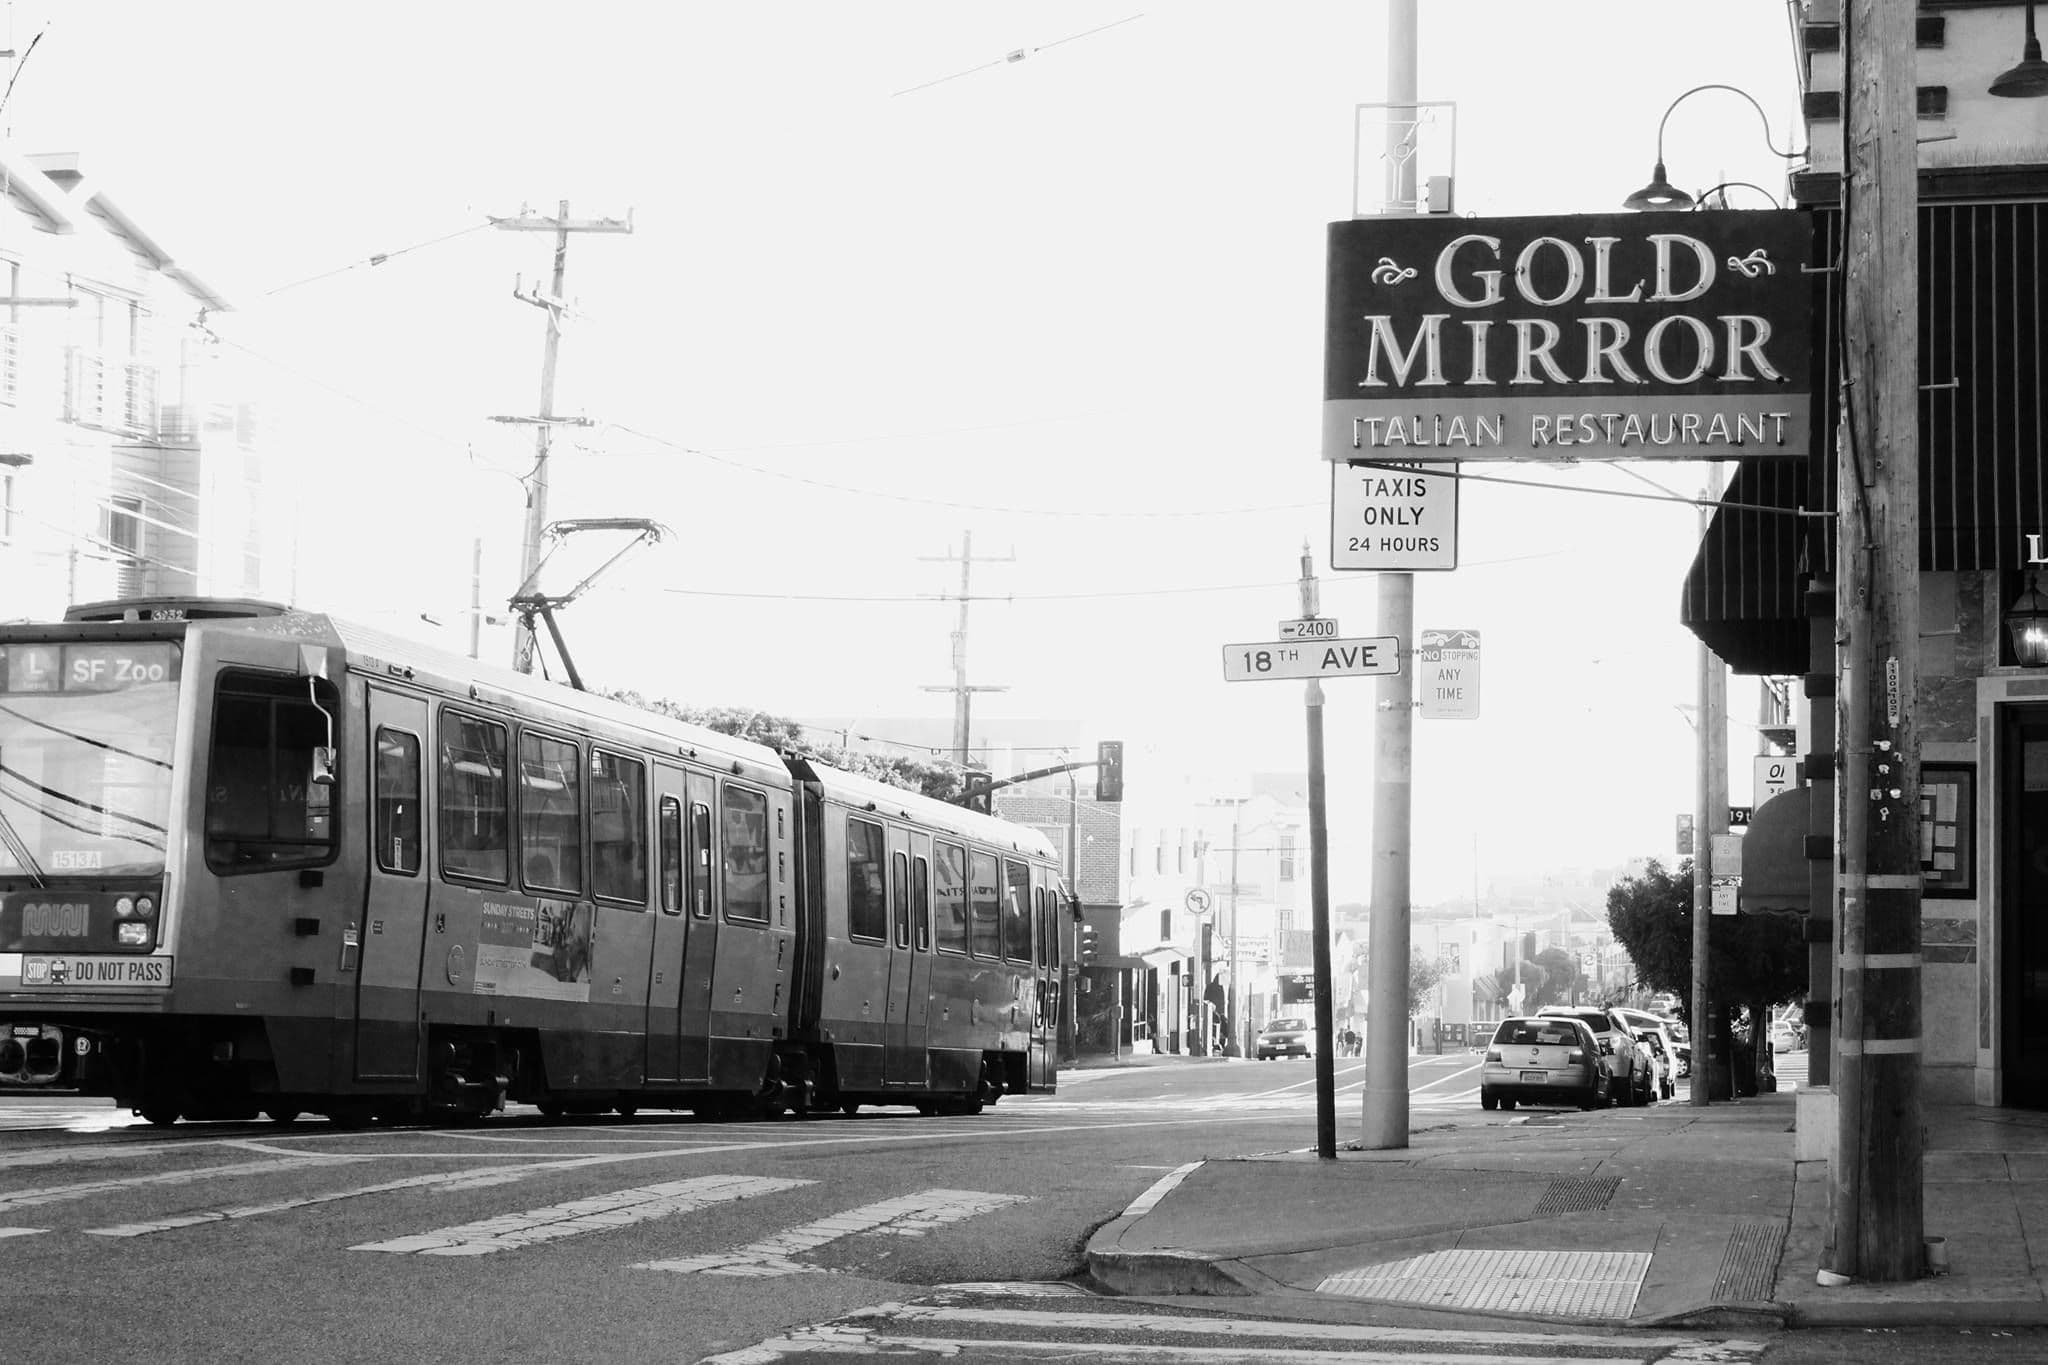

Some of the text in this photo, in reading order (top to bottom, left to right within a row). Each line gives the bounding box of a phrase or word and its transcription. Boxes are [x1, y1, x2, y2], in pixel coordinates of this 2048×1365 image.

[1435, 234, 1716, 308] GOLD
[1358, 313, 1790, 388] MIRROR
[1353, 411, 1792, 448] ITALIAN RESTAURANT
[1361, 478, 1427, 497] TAXIS
[1363, 506, 1425, 526] ONLY
[1348, 537, 1440, 552] 24 HOURS
[1297, 621, 1334, 637] 2400
[29, 652, 44, 675] L
[1321, 645, 1379, 669] AVE
[1423, 650, 1479, 661] NO STOPPING
[72, 658, 164, 683] SF Zoo
[1438, 668, 1462, 681] ANY
[1436, 687, 1464, 700] TIME
[26, 961, 48, 980] STOP
[75, 962, 163, 981] DO NOT PASS
